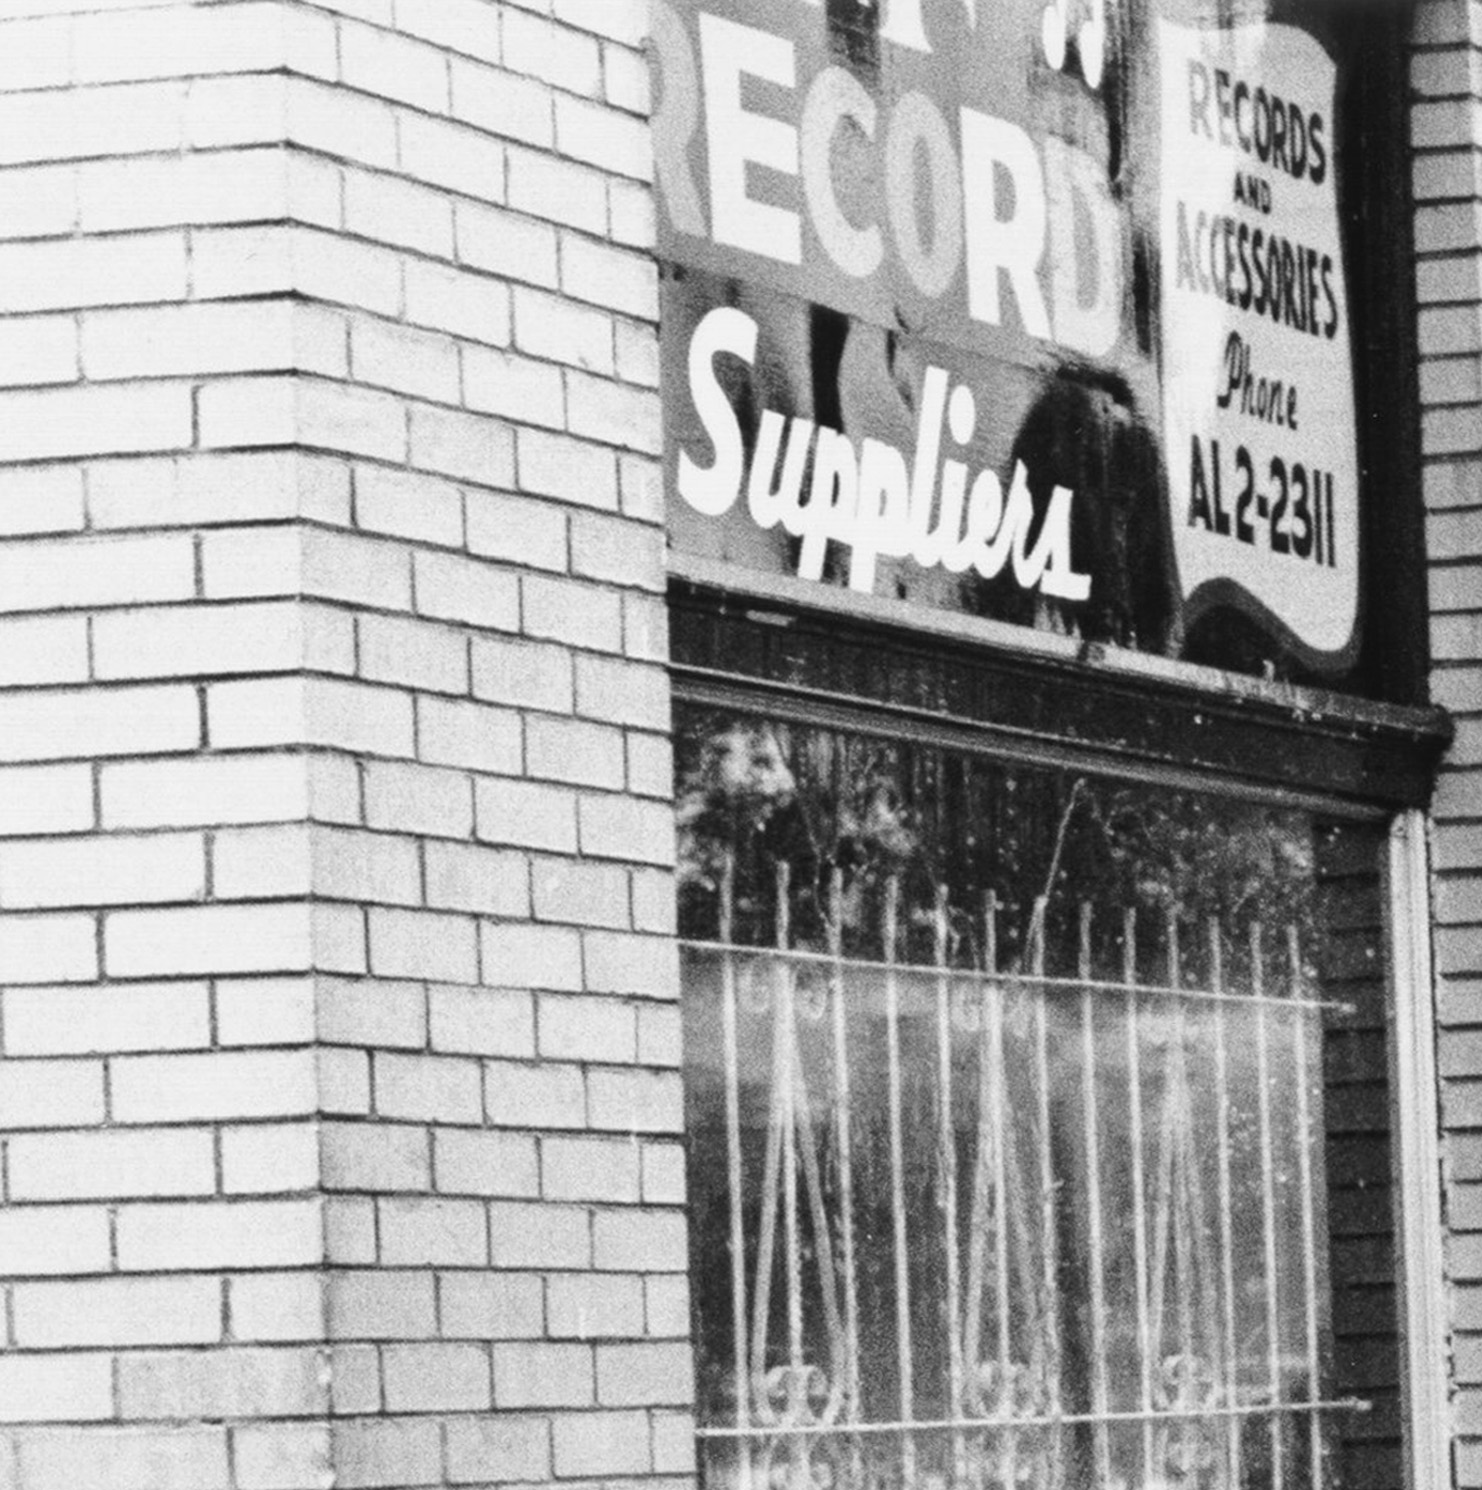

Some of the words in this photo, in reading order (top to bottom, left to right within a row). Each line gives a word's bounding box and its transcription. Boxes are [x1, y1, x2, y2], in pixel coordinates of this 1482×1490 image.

[1188, 58, 1326, 186] RECORDS
[1233, 171, 1273, 214] AND
[1176, 199, 1338, 340] ACCESSORIES
[1216, 330, 1298, 431] Phone
[678, 306, 1092, 600] Suppliers
